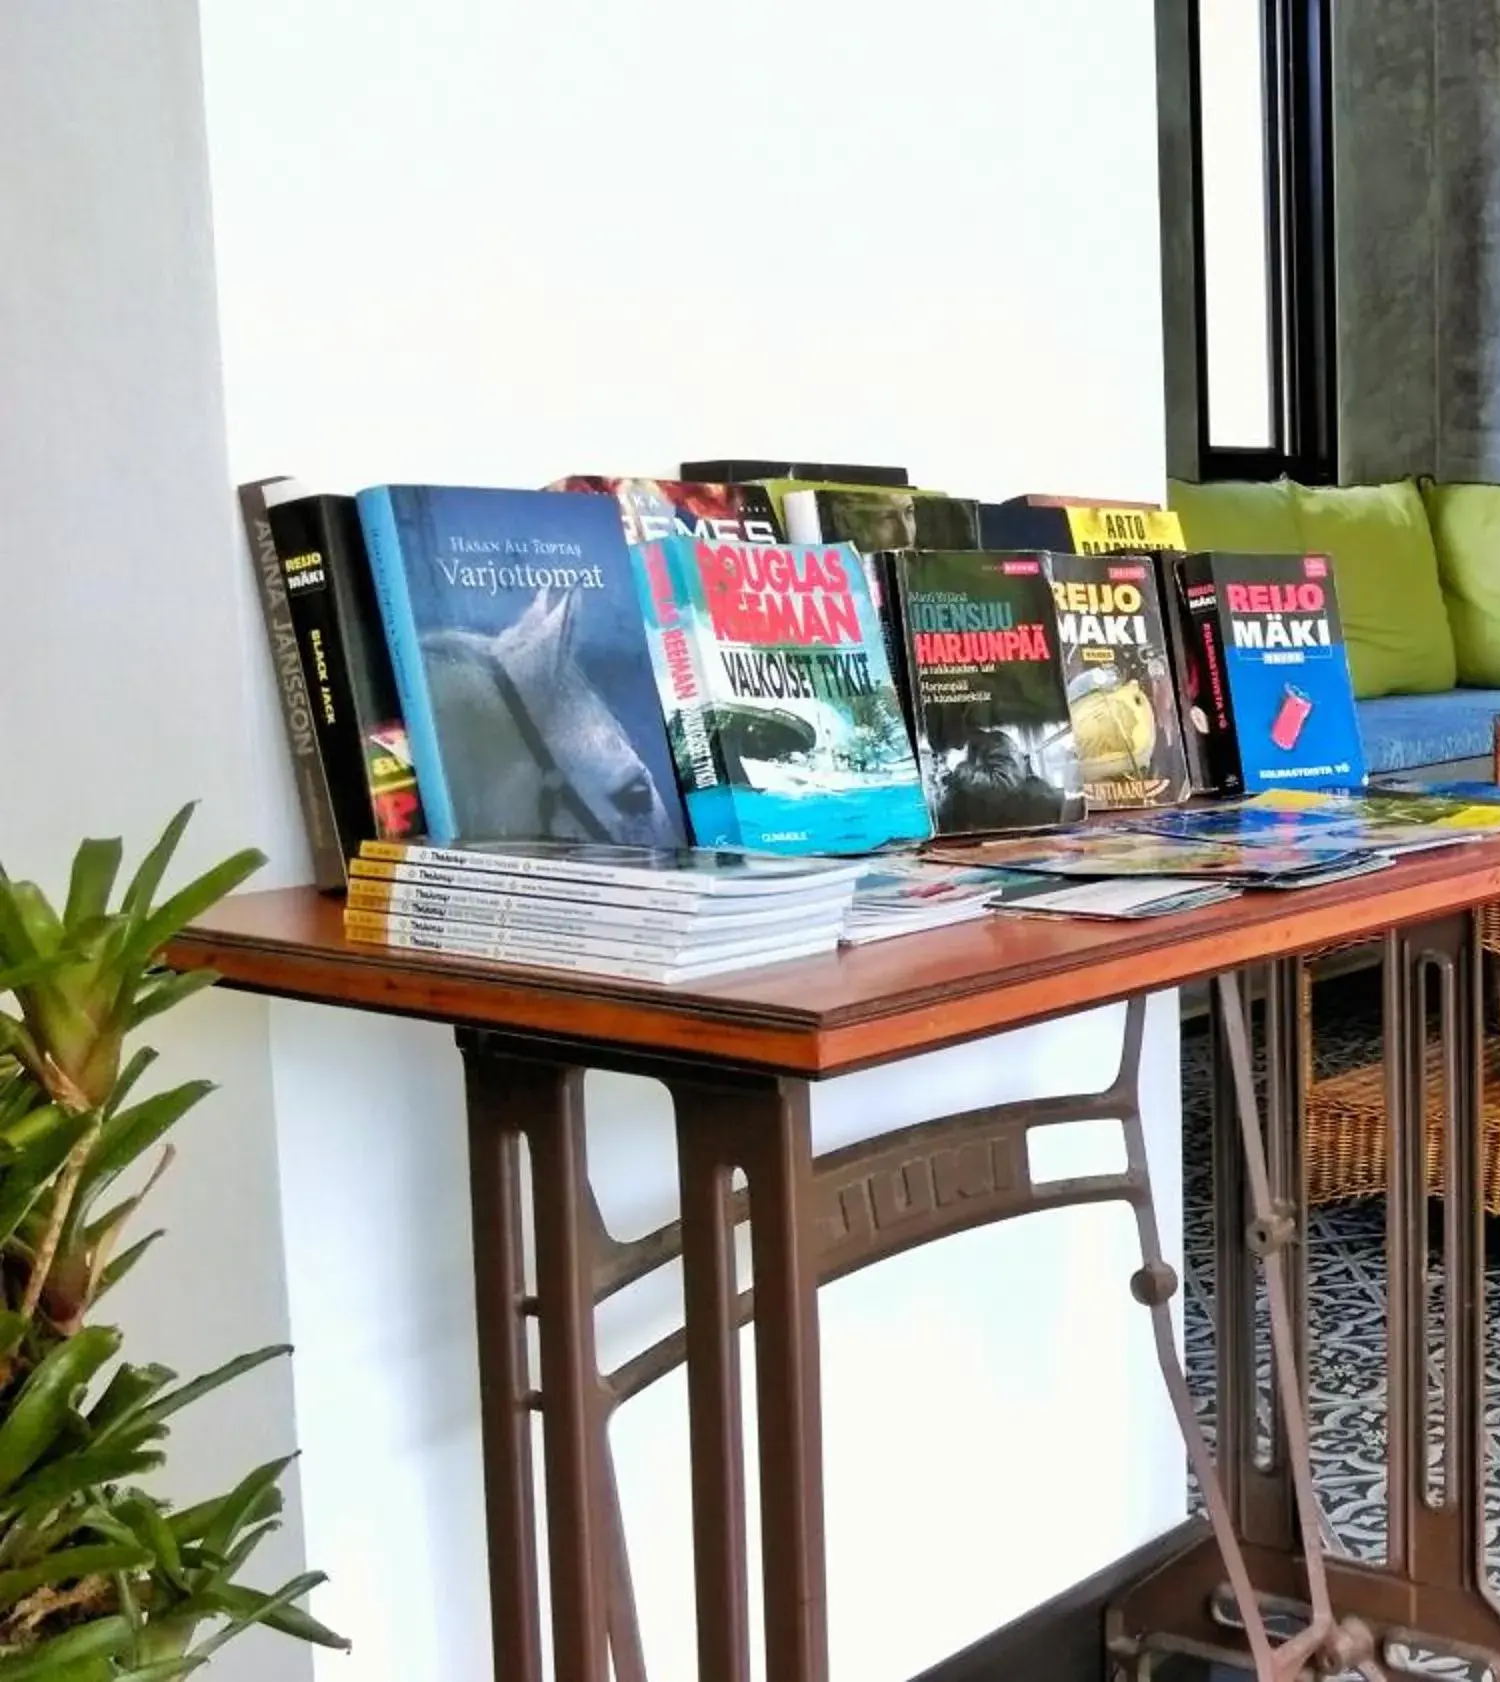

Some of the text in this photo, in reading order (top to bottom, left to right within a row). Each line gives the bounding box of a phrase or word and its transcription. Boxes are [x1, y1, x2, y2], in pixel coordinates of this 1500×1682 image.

[1105, 514, 1146, 540] ARTO
[285, 551, 322, 572] REIJO
[288, 569, 325, 589] MÄKI
[436, 558, 605, 597] Varjottomat
[695, 541, 848, 593] DOUGLAS
[911, 602, 1013, 632] JOENSUU
[1052, 582, 1141, 613] REIJO
[1227, 584, 1324, 611] REIJO
[254, 520, 315, 757] ANNA JANSSON
[914, 624, 1050, 665] HARJUNPÄÄ
[1231, 614, 1331, 649] MÄKI
[311, 628, 336, 725] BLACK JACK
[660, 628, 699, 700] REEMAN
[720, 651, 818, 698] VALKOISET
[816, 652, 877, 698] TYKIT
[820, 1138, 1015, 1244] JUKI
